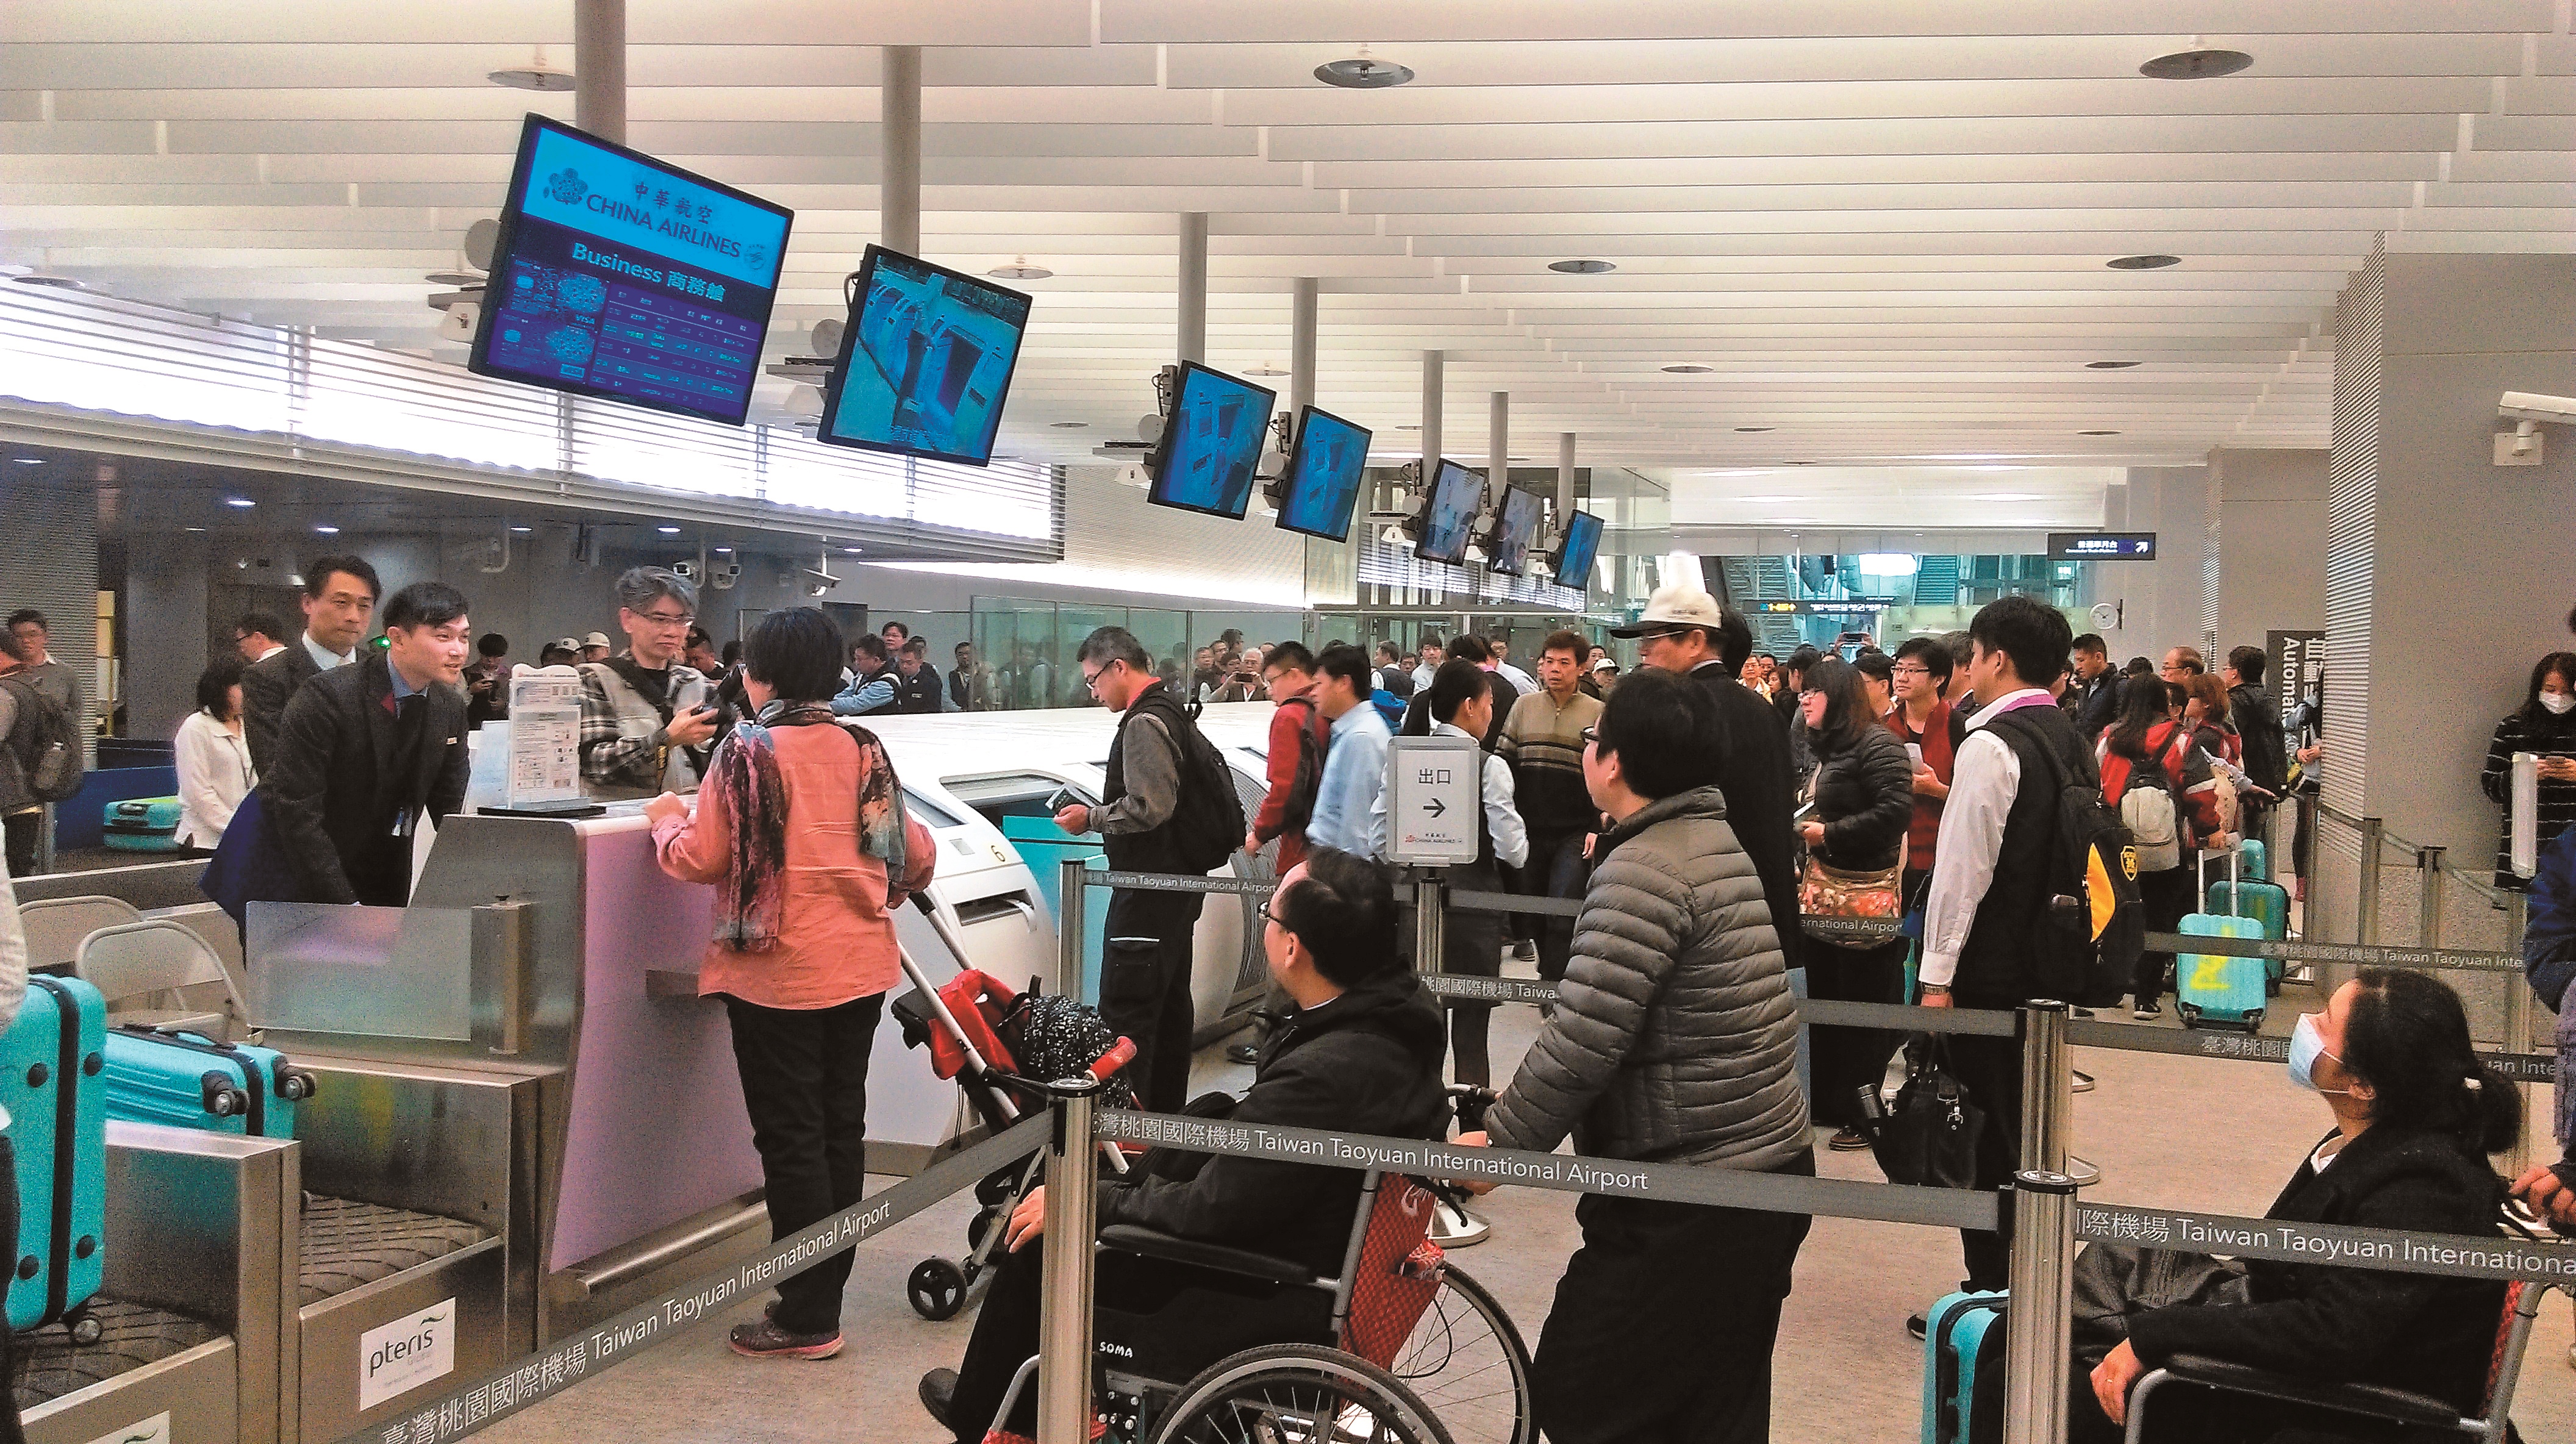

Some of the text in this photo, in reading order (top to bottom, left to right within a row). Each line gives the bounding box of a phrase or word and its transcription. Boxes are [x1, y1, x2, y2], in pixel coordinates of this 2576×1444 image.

[635, 180, 713, 225] 中華航空
[586, 193, 742, 258] CHINA AIRLINES
[572, 243, 726, 302] Business 商務艙
[1419, 767, 1451, 785] 出口
[990, 845, 1006, 862] 6
[1104, 872, 1136, 884] Taiwan
[1138, 875, 1178, 888] Taoyuan
[1180, 877, 1240, 890] International
[1240, 882, 1277, 893] Airport
[1861, 919, 1903, 934] Airpor
[2382, 949, 2430, 963] Taiwan
[2433, 952, 2492, 968] Taoyuan
[1515, 983, 1560, 999] Taiwa
[1092, 1112, 1648, 1192] 灣桃園國際機場 Taiwan Taoyuan International Airport
[2175, 1218, 2269, 1248] Taiwan
[2276, 1227, 2394, 1260] Taoyuan
[2403, 1238, 2576, 1276] Internationa
[591, 1315, 659, 1360] Taiwan
[662, 1277, 736, 1326] Taoyuan
[740, 1221, 838, 1290] International
[840, 1199, 890, 1241] Airport
[370, 1329, 434, 1378] pteris
[1099, 1341, 1133, 1358] SOMA
